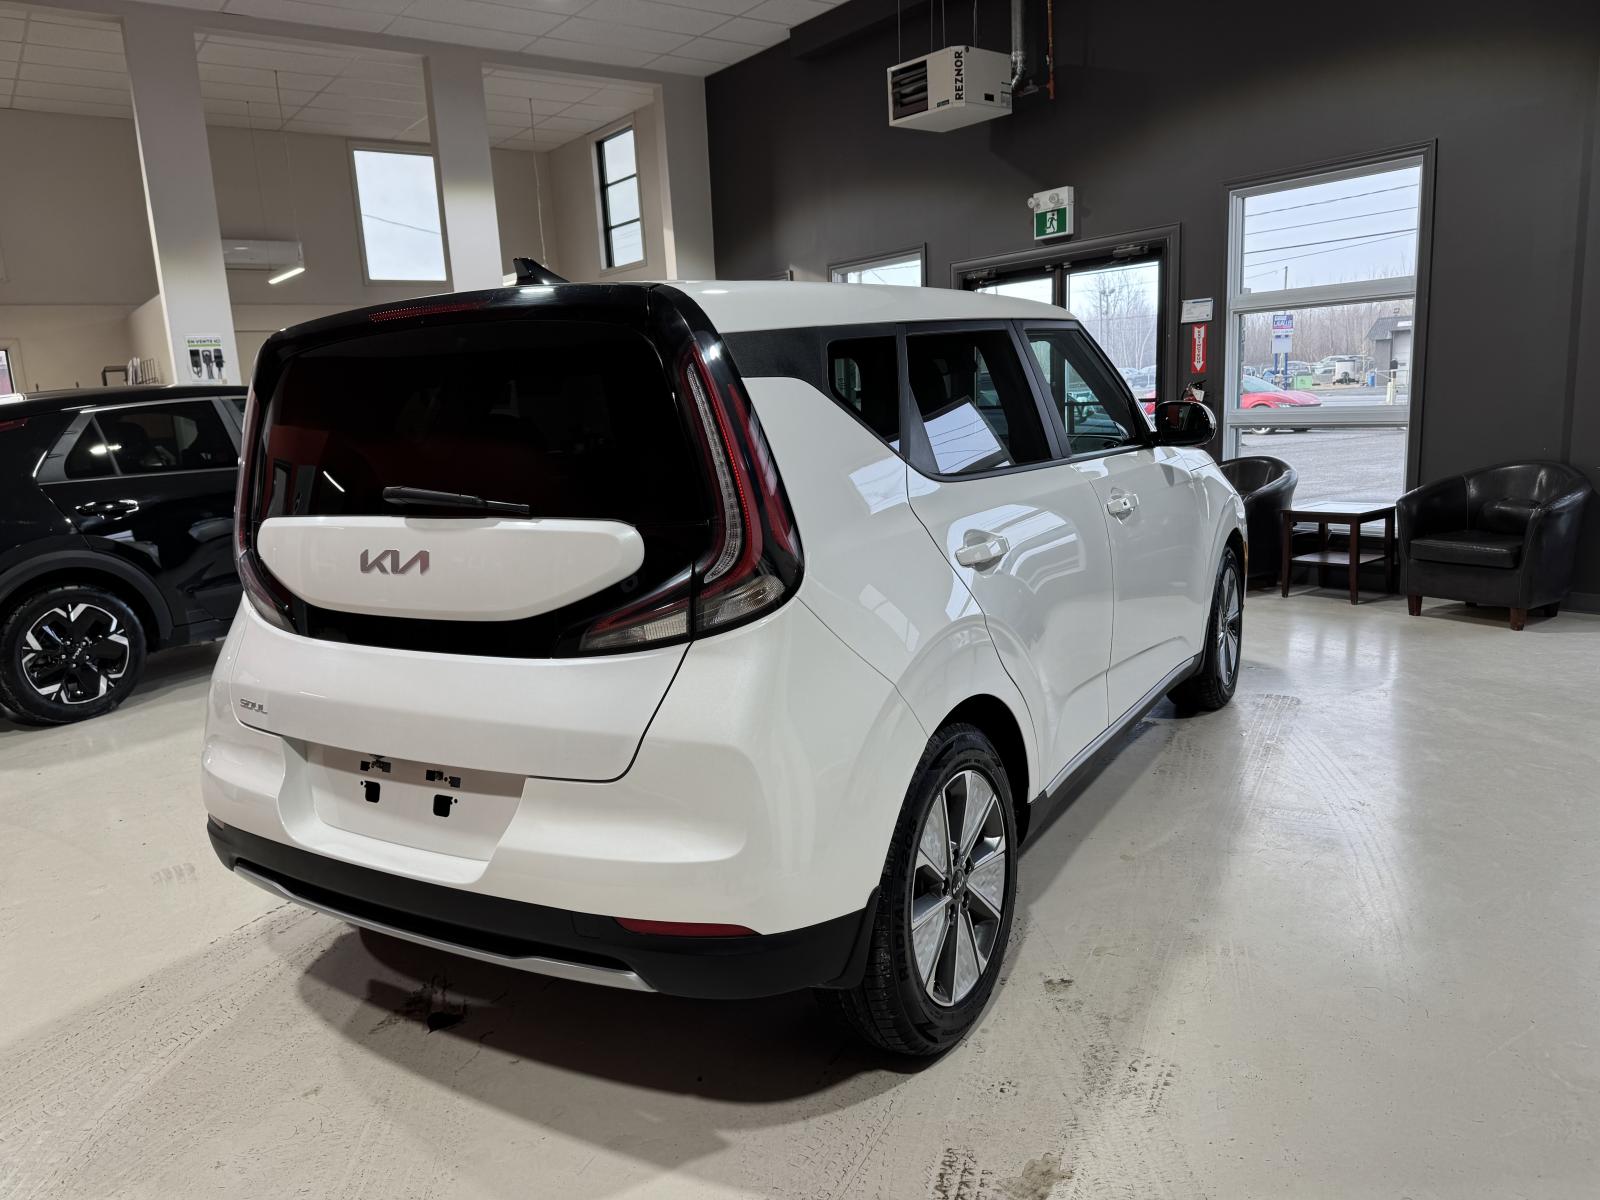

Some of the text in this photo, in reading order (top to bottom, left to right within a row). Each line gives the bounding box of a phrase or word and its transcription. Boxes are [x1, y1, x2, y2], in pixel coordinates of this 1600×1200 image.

[954, 50, 964, 101] REZNOR
[360, 548, 430, 575] KIA
[240, 698, 268, 715] SOUL
